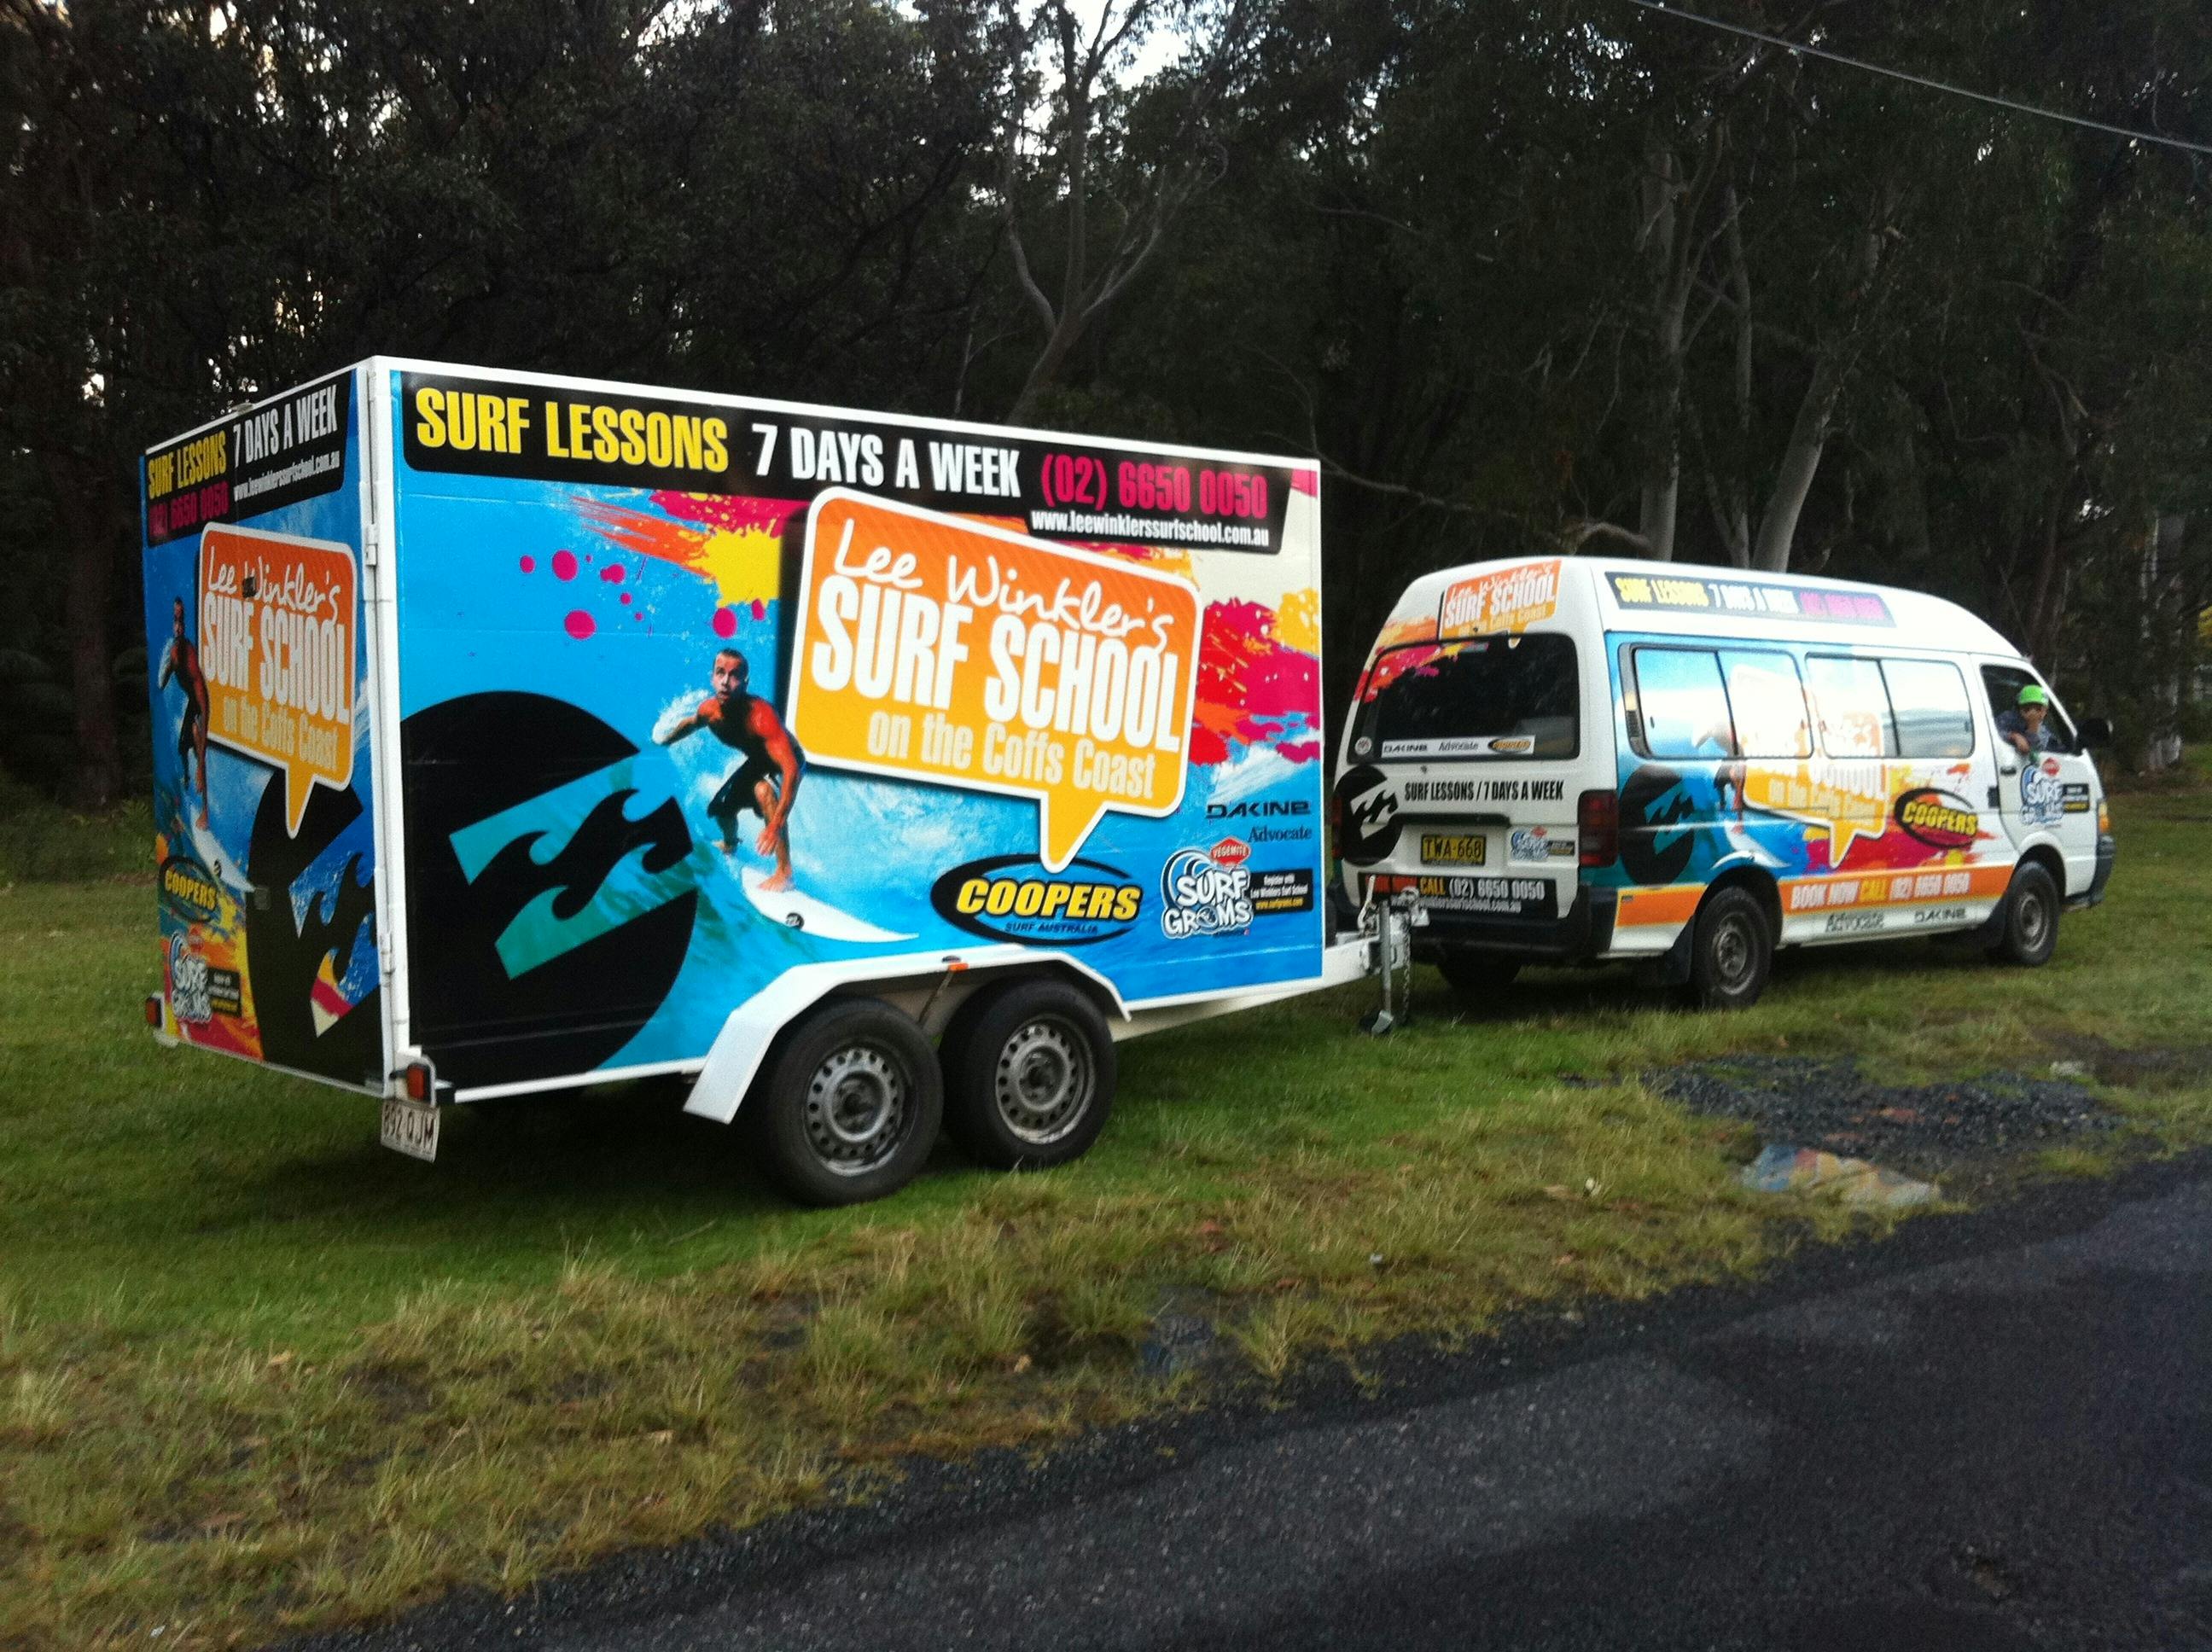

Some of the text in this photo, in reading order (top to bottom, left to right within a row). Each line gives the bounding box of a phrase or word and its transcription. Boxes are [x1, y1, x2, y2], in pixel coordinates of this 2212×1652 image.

[233, 384, 338, 468] 7 DAYS A WEEK
[416, 387, 1022, 498] SURF LESSONS 7 DAYS A WEEK
[148, 431, 226, 500] SURF LESSONS
[1040, 452, 1268, 521] (02) 6650 0050
[1031, 510, 1270, 547] www.leewinklerssurfschool.com.au
[208, 545, 341, 624] Lee Winkler's
[834, 518, 1174, 655] Lee Winkler's
[1445, 591, 1487, 630] SURF
[1490, 573, 1554, 616] SCHOOL
[202, 593, 350, 725] SURF SCHOOL
[812, 574, 1180, 753] SURF SCHOOL
[866, 710, 1155, 800] on the Coffs Coast
[1206, 801, 1311, 819] DAKINE
[1405, 781, 1429, 801] SURF
[1430, 781, 1475, 801] LESSONS
[1491, 781, 1519, 800] DAYS
[1520, 781, 1529, 800] A
[1531, 780, 1564, 800] WEEK
[1247, 824, 1313, 842] Advocate
[1902, 801, 1978, 835] COOPERS
[165, 868, 216, 911] COOPERS
[955, 877, 1143, 920] COOPERS
[1176, 869, 1249, 907] SURF
[1419, 877, 1446, 895] CALL
[1449, 877, 1475, 899] (02)
[1004, 922, 1099, 934] SURF AUSTRALIA
